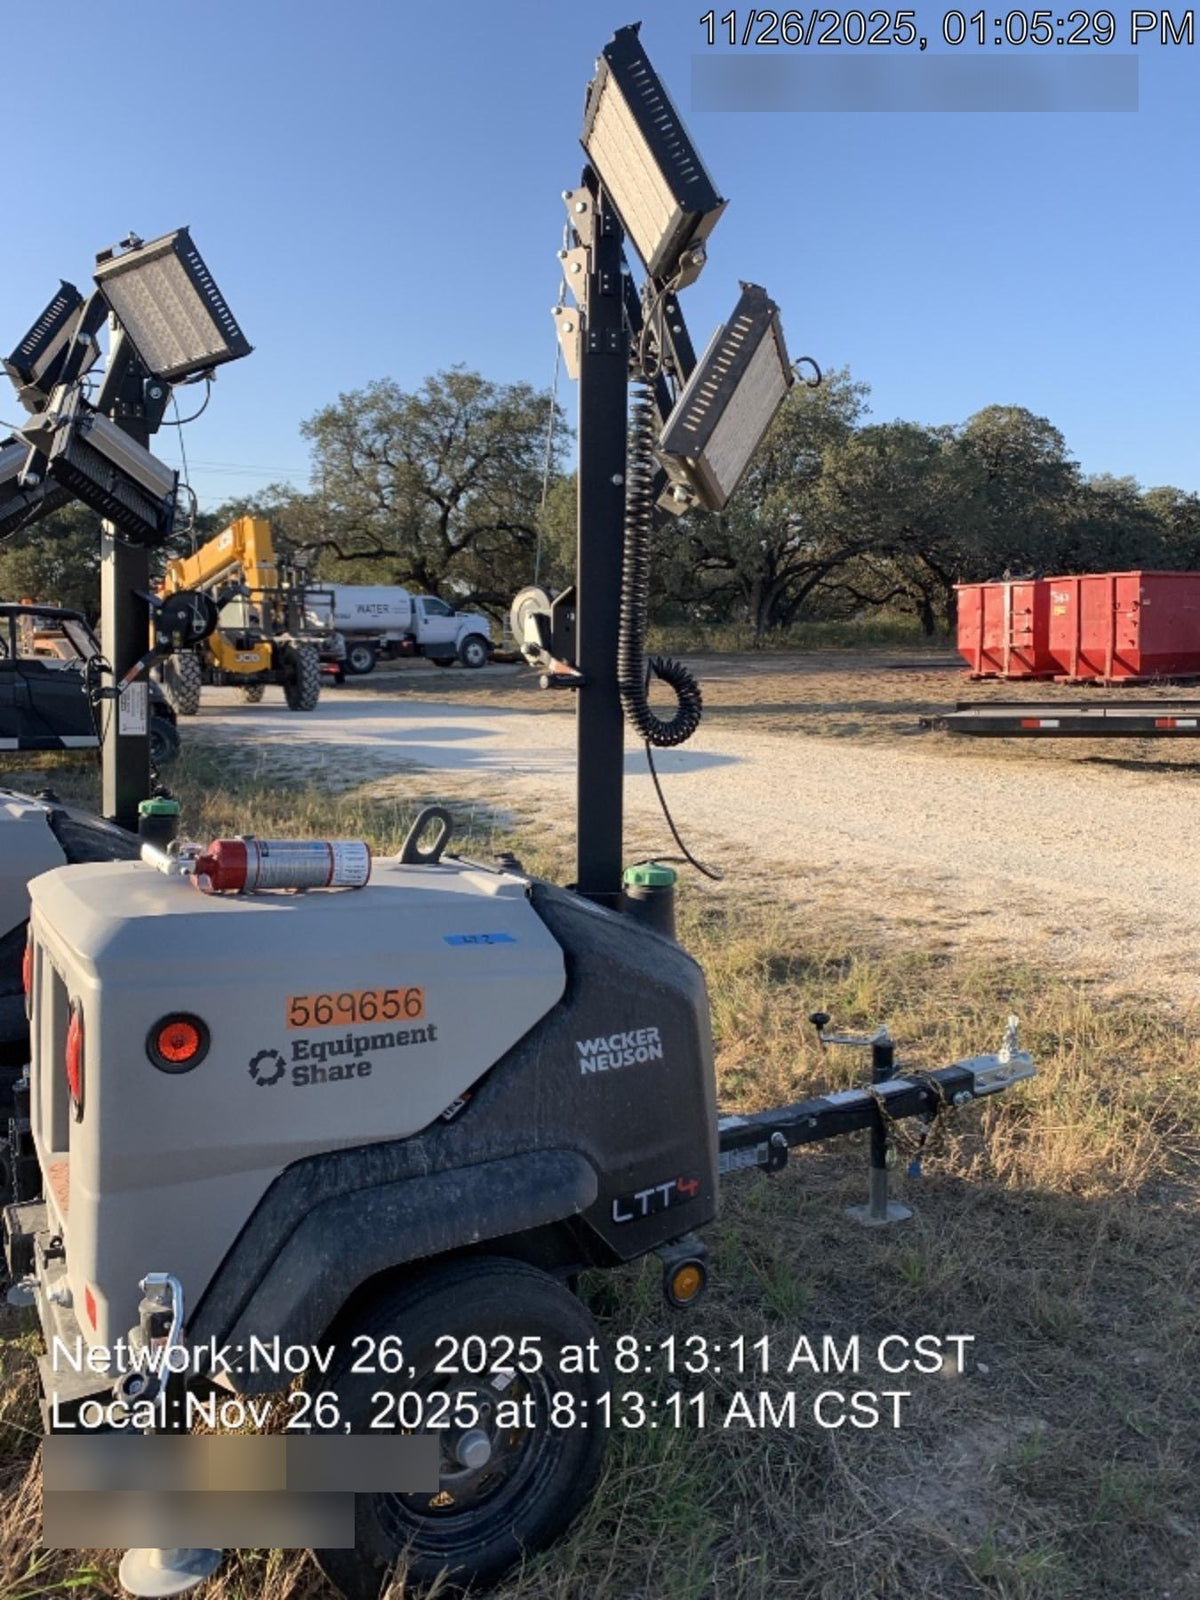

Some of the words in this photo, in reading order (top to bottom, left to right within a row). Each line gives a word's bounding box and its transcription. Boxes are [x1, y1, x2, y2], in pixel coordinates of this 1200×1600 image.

[356, 604, 390, 614] WATER
[290, 987, 423, 1027] 569656
[291, 1023, 438, 1062] Equipment
[575, 1026, 661, 1057] WACKER
[291, 1060, 373, 1087] Share
[580, 1043, 664, 1075] NEUSON
